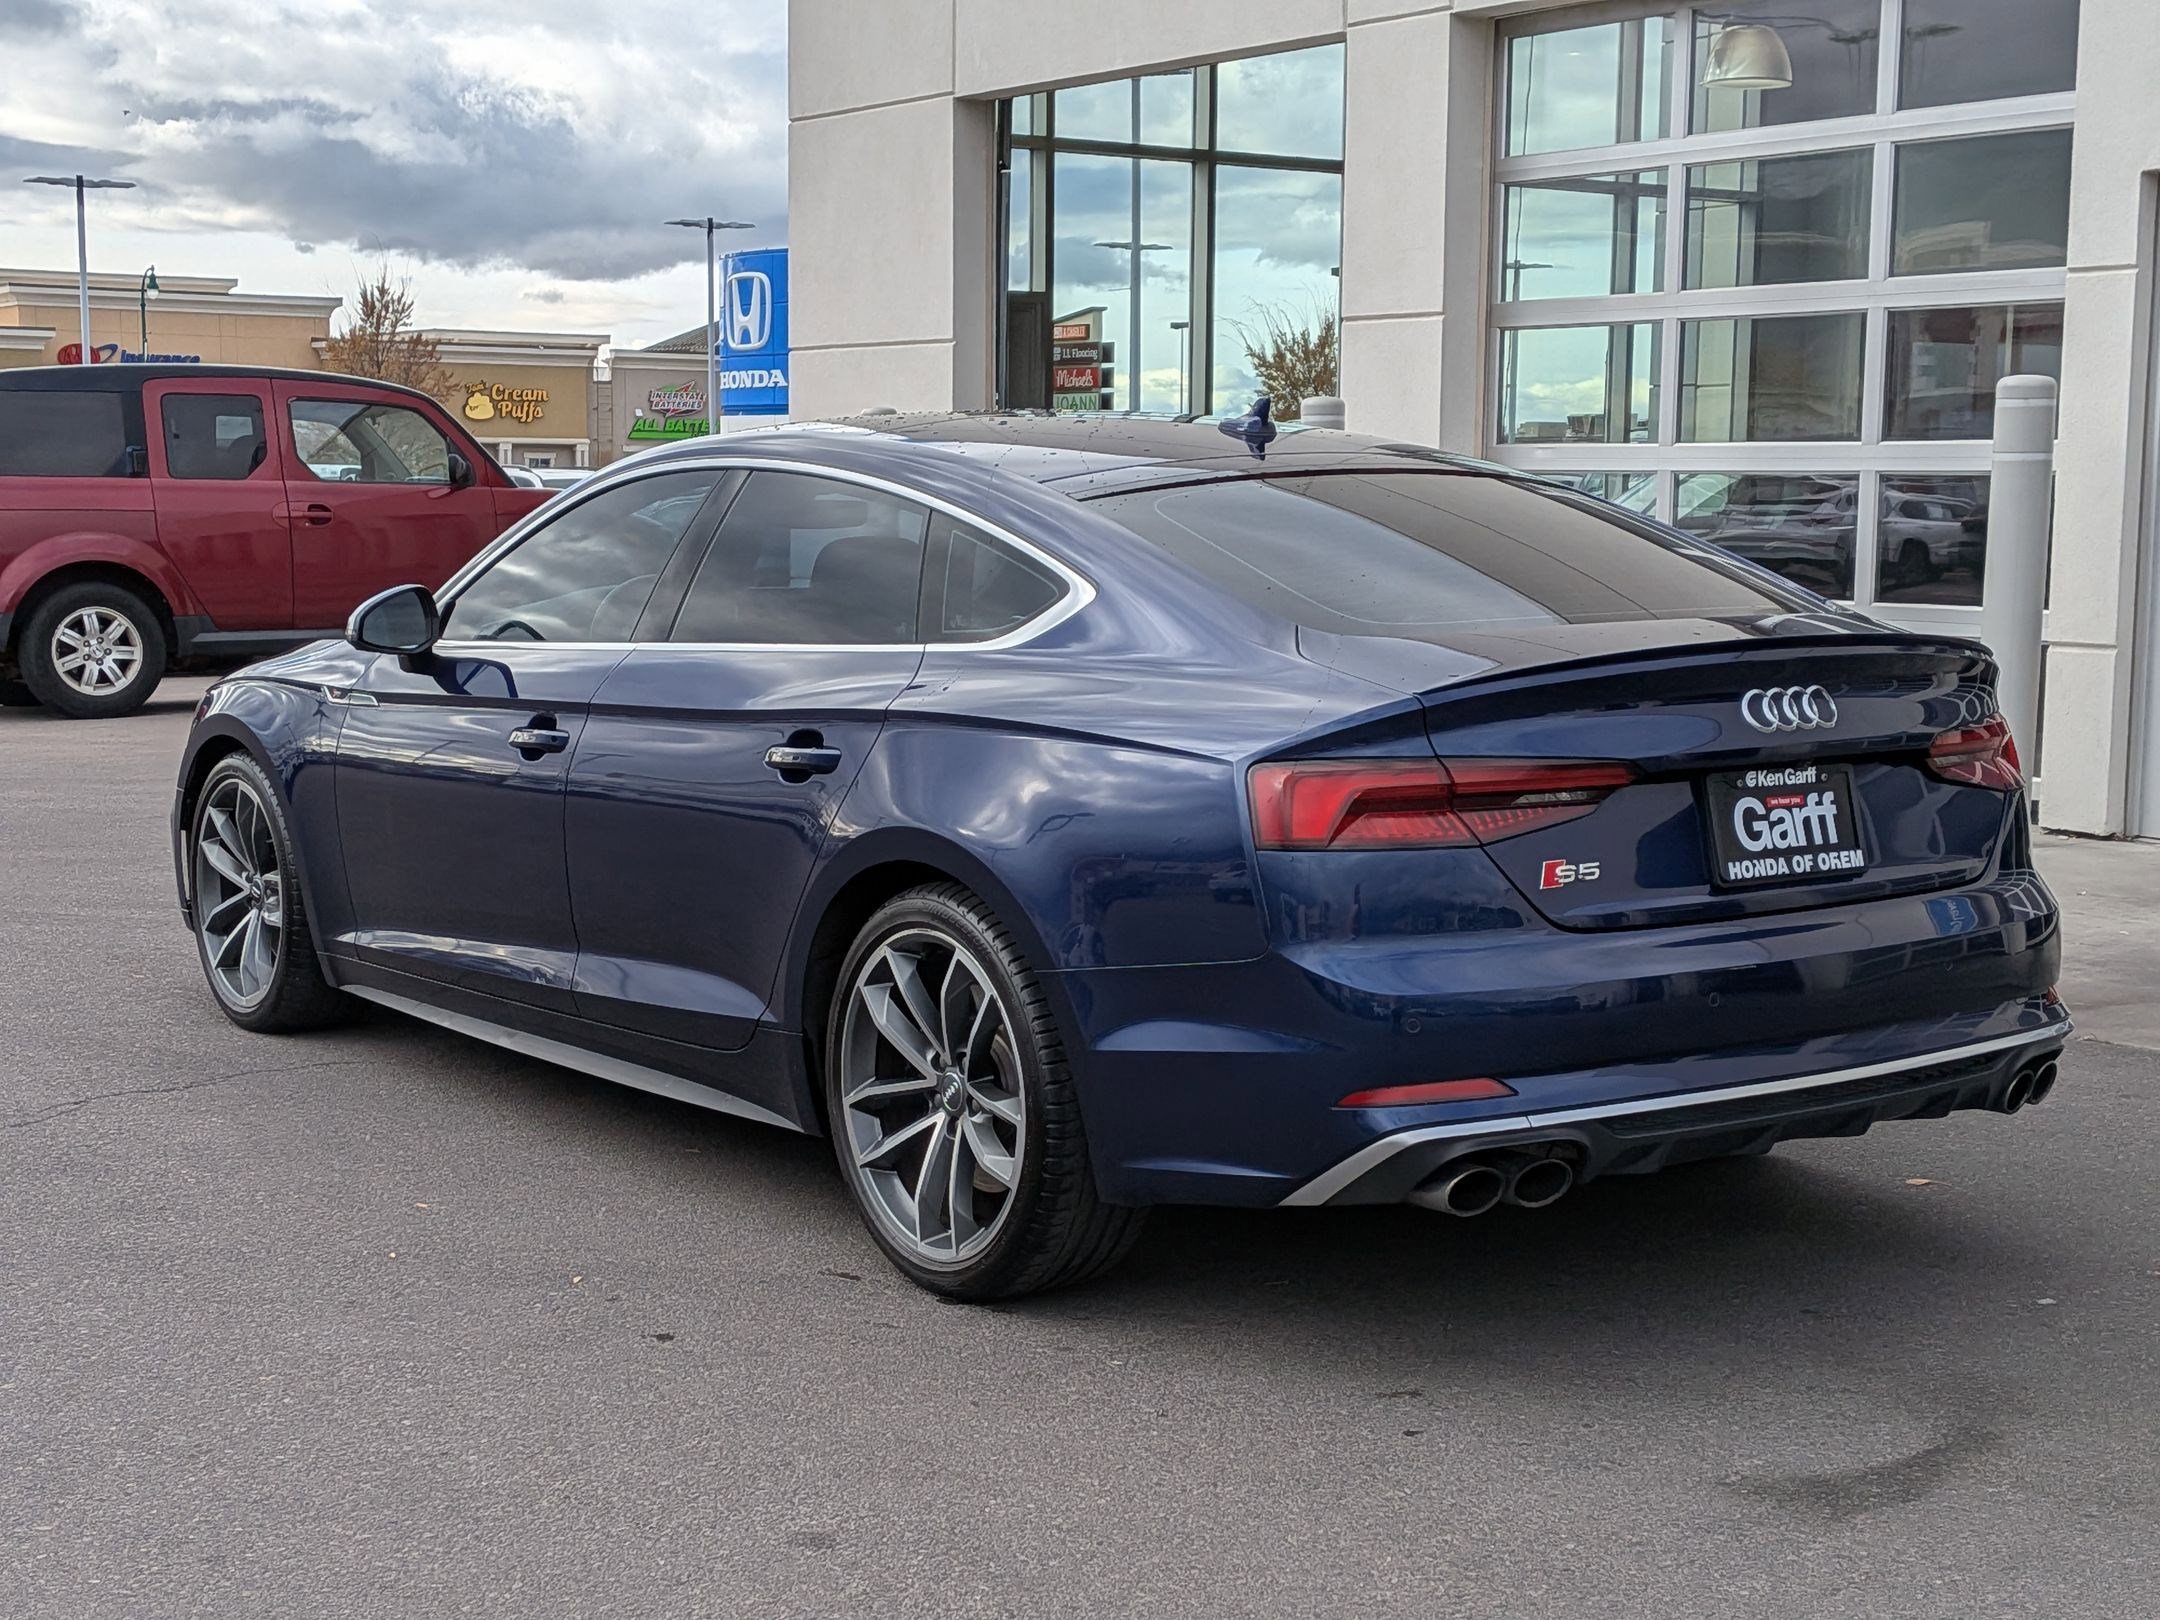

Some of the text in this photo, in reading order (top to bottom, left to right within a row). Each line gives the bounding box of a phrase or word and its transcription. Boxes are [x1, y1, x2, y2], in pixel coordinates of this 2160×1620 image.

[720, 369, 788, 389] HONDA
[1056, 369, 1093, 387] Michaels
[491, 383, 549, 401] Cream
[650, 390, 706, 401] INTERSTATE
[497, 401, 544, 423] Puffs
[652, 400, 704, 409] BATTERIES
[634, 418, 660, 430] ALL
[1734, 791, 1839, 852] Garff
[1554, 861, 1600, 883] S5
[1728, 849, 1864, 880] HONDA OF OREM
